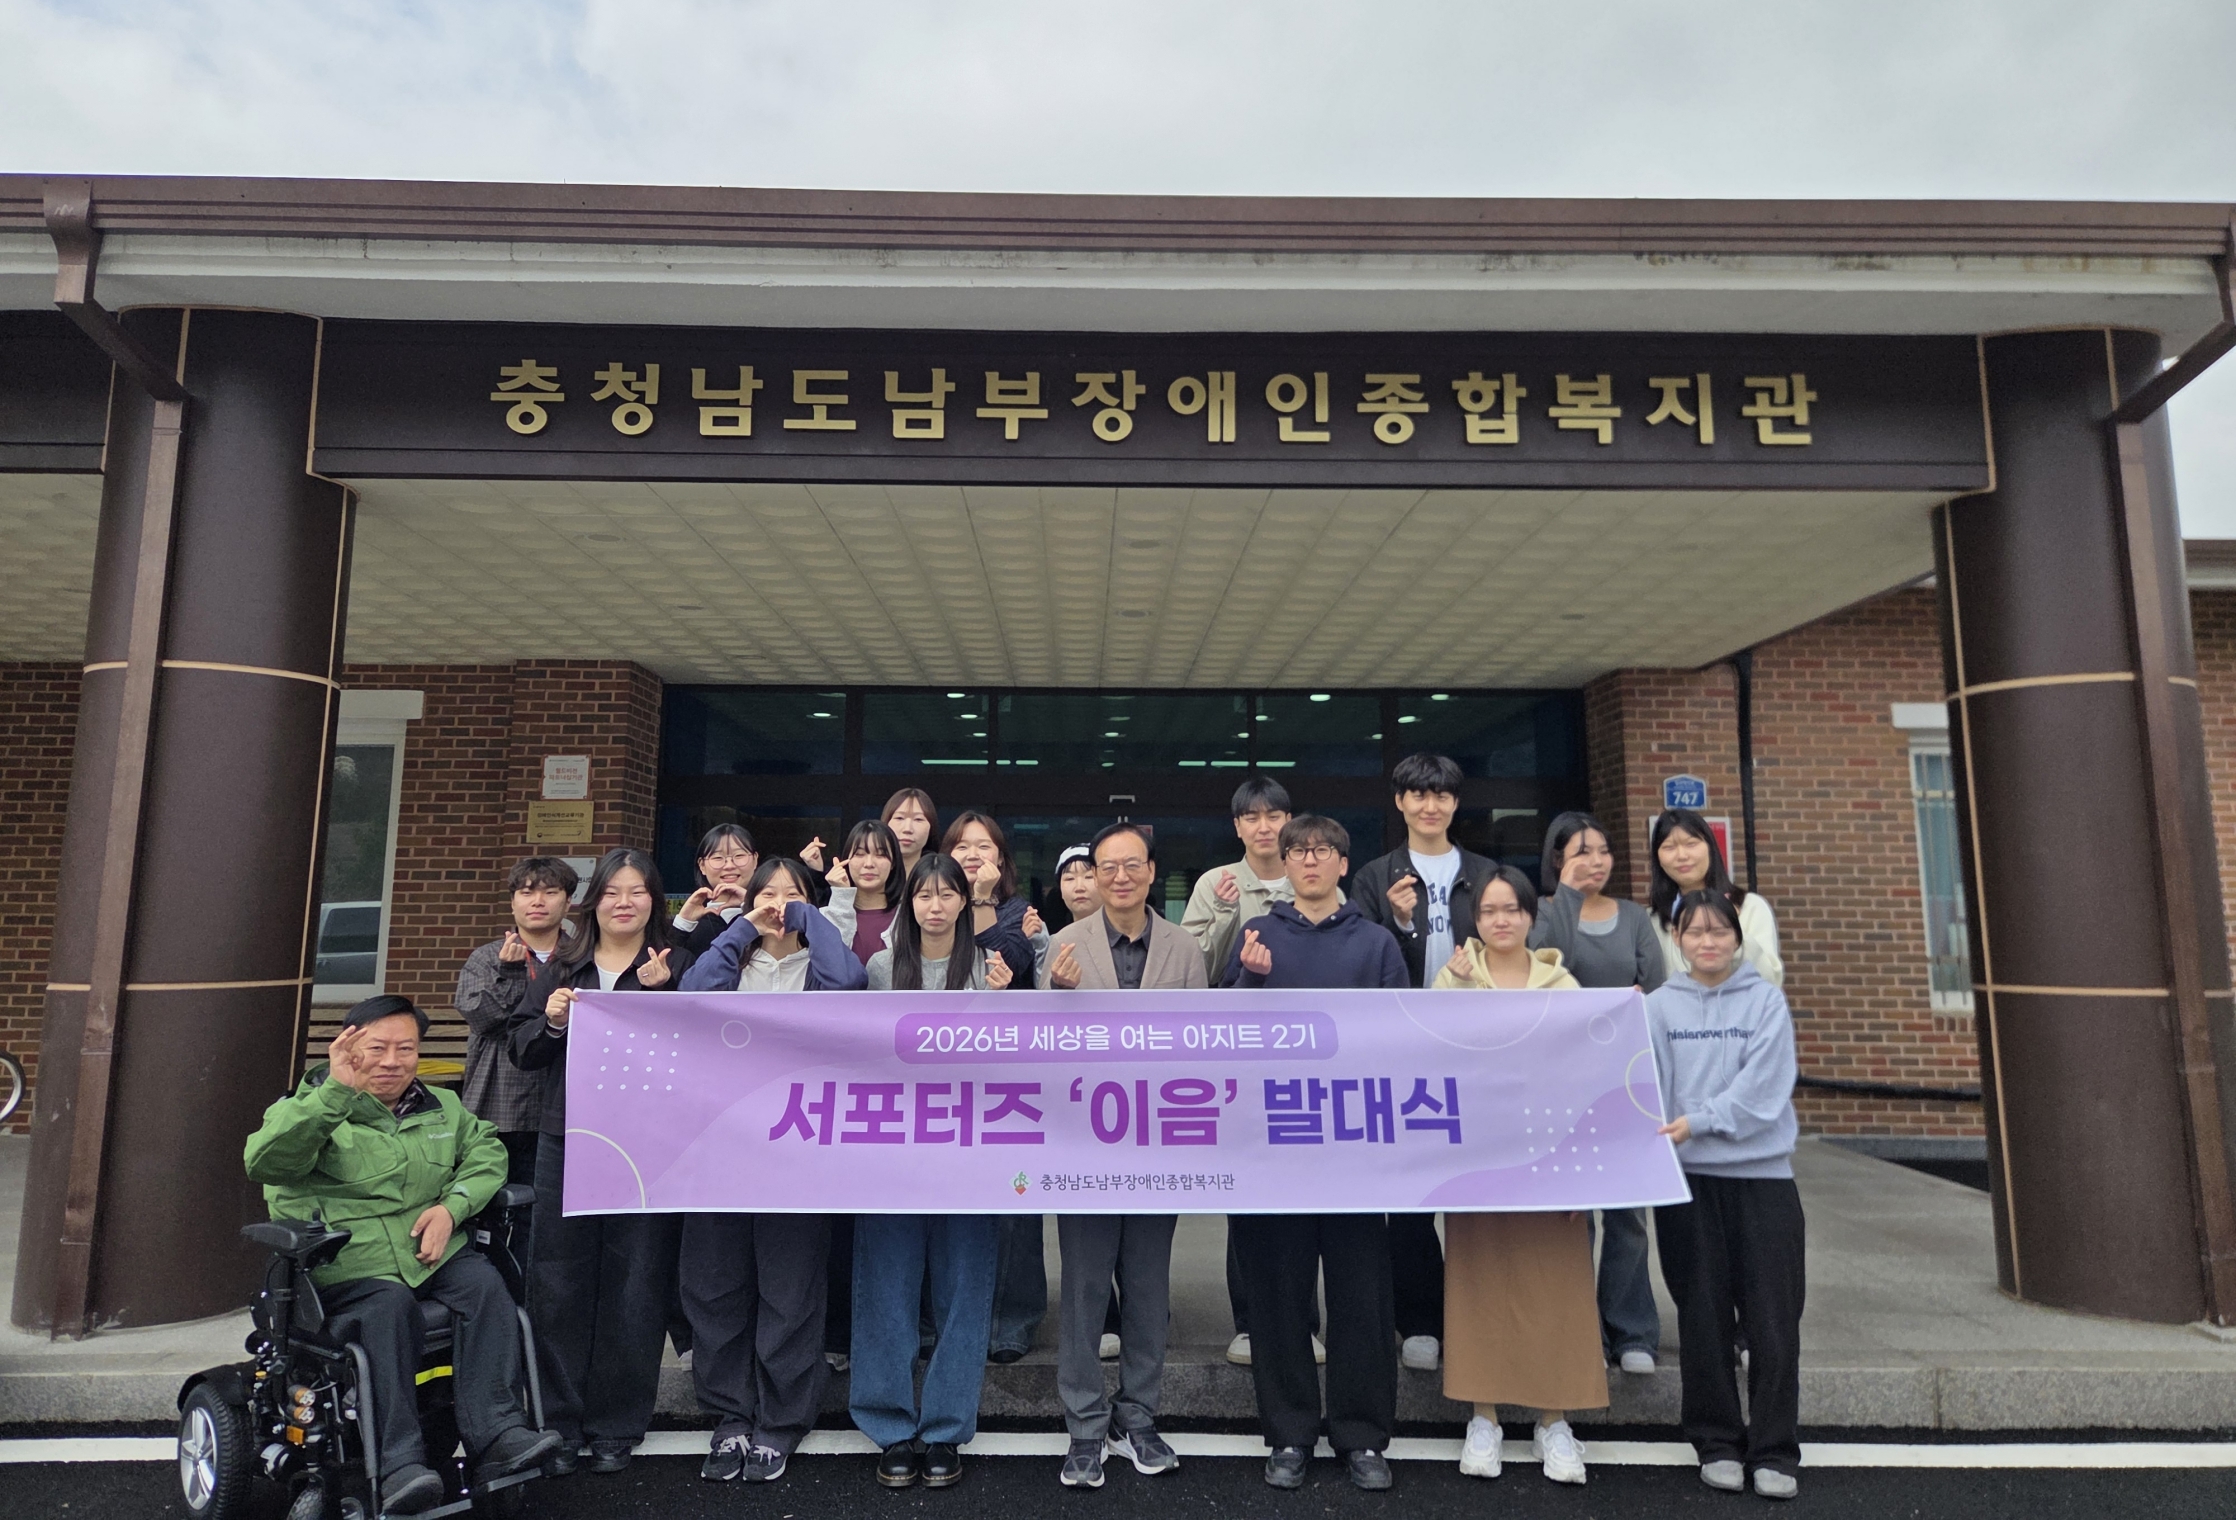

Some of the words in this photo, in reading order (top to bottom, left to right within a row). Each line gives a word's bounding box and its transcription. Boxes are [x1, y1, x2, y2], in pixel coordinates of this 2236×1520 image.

[490, 359, 1818, 445] 충청남도남부장애인종합복지관
[1672, 791, 1698, 805] 747
[915, 1026, 1019, 1053] 2026년
[1029, 1024, 1110, 1051] 세상을
[1120, 1024, 1174, 1051] 여는
[1182, 1023, 1264, 1050] 아지트
[1271, 1023, 1316, 1050] 2기
[768, 1080, 1045, 1147] 서포터즈
[1263, 1077, 1462, 1145] 발대식
[1039, 1173, 1236, 1192] 충청남도남부장애인종합복지관
